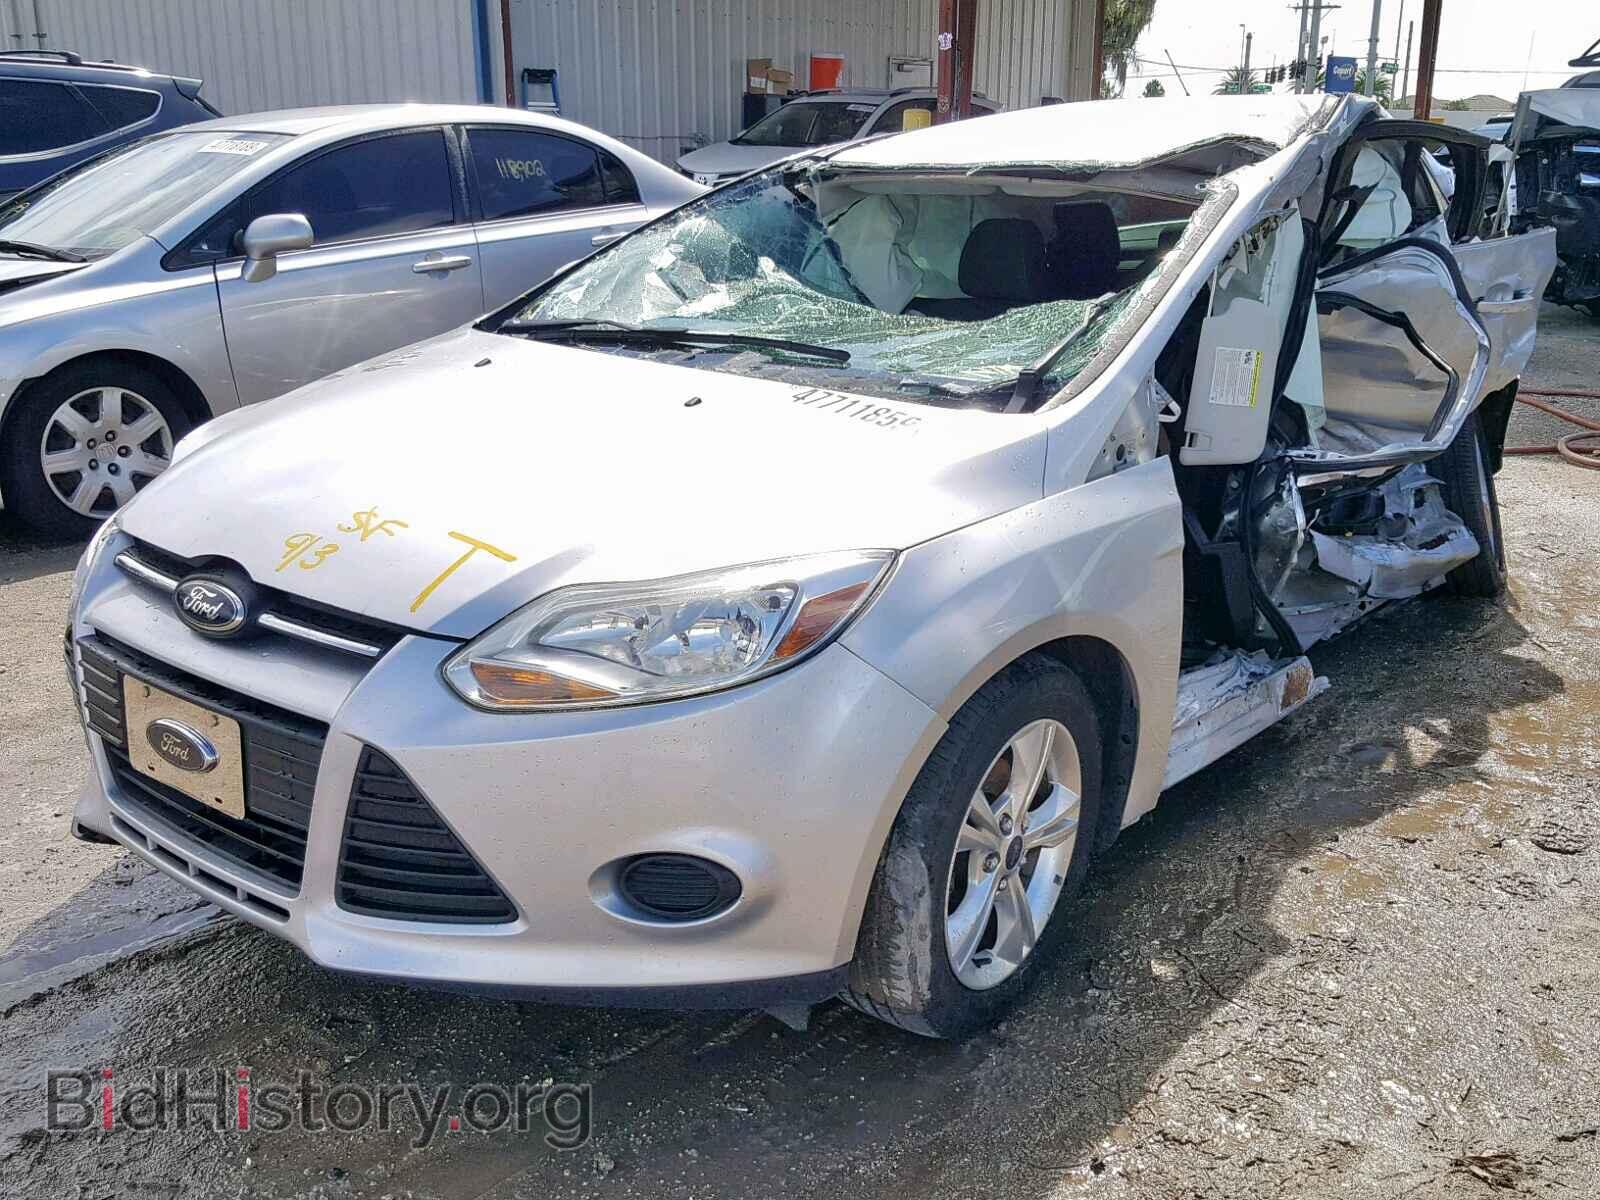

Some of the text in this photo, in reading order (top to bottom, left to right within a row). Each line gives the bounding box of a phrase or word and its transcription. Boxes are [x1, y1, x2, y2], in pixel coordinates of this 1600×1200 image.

[409, 530, 517, 615] T
[183, 585, 224, 620] Ford
[160, 732, 190, 761] Ford
